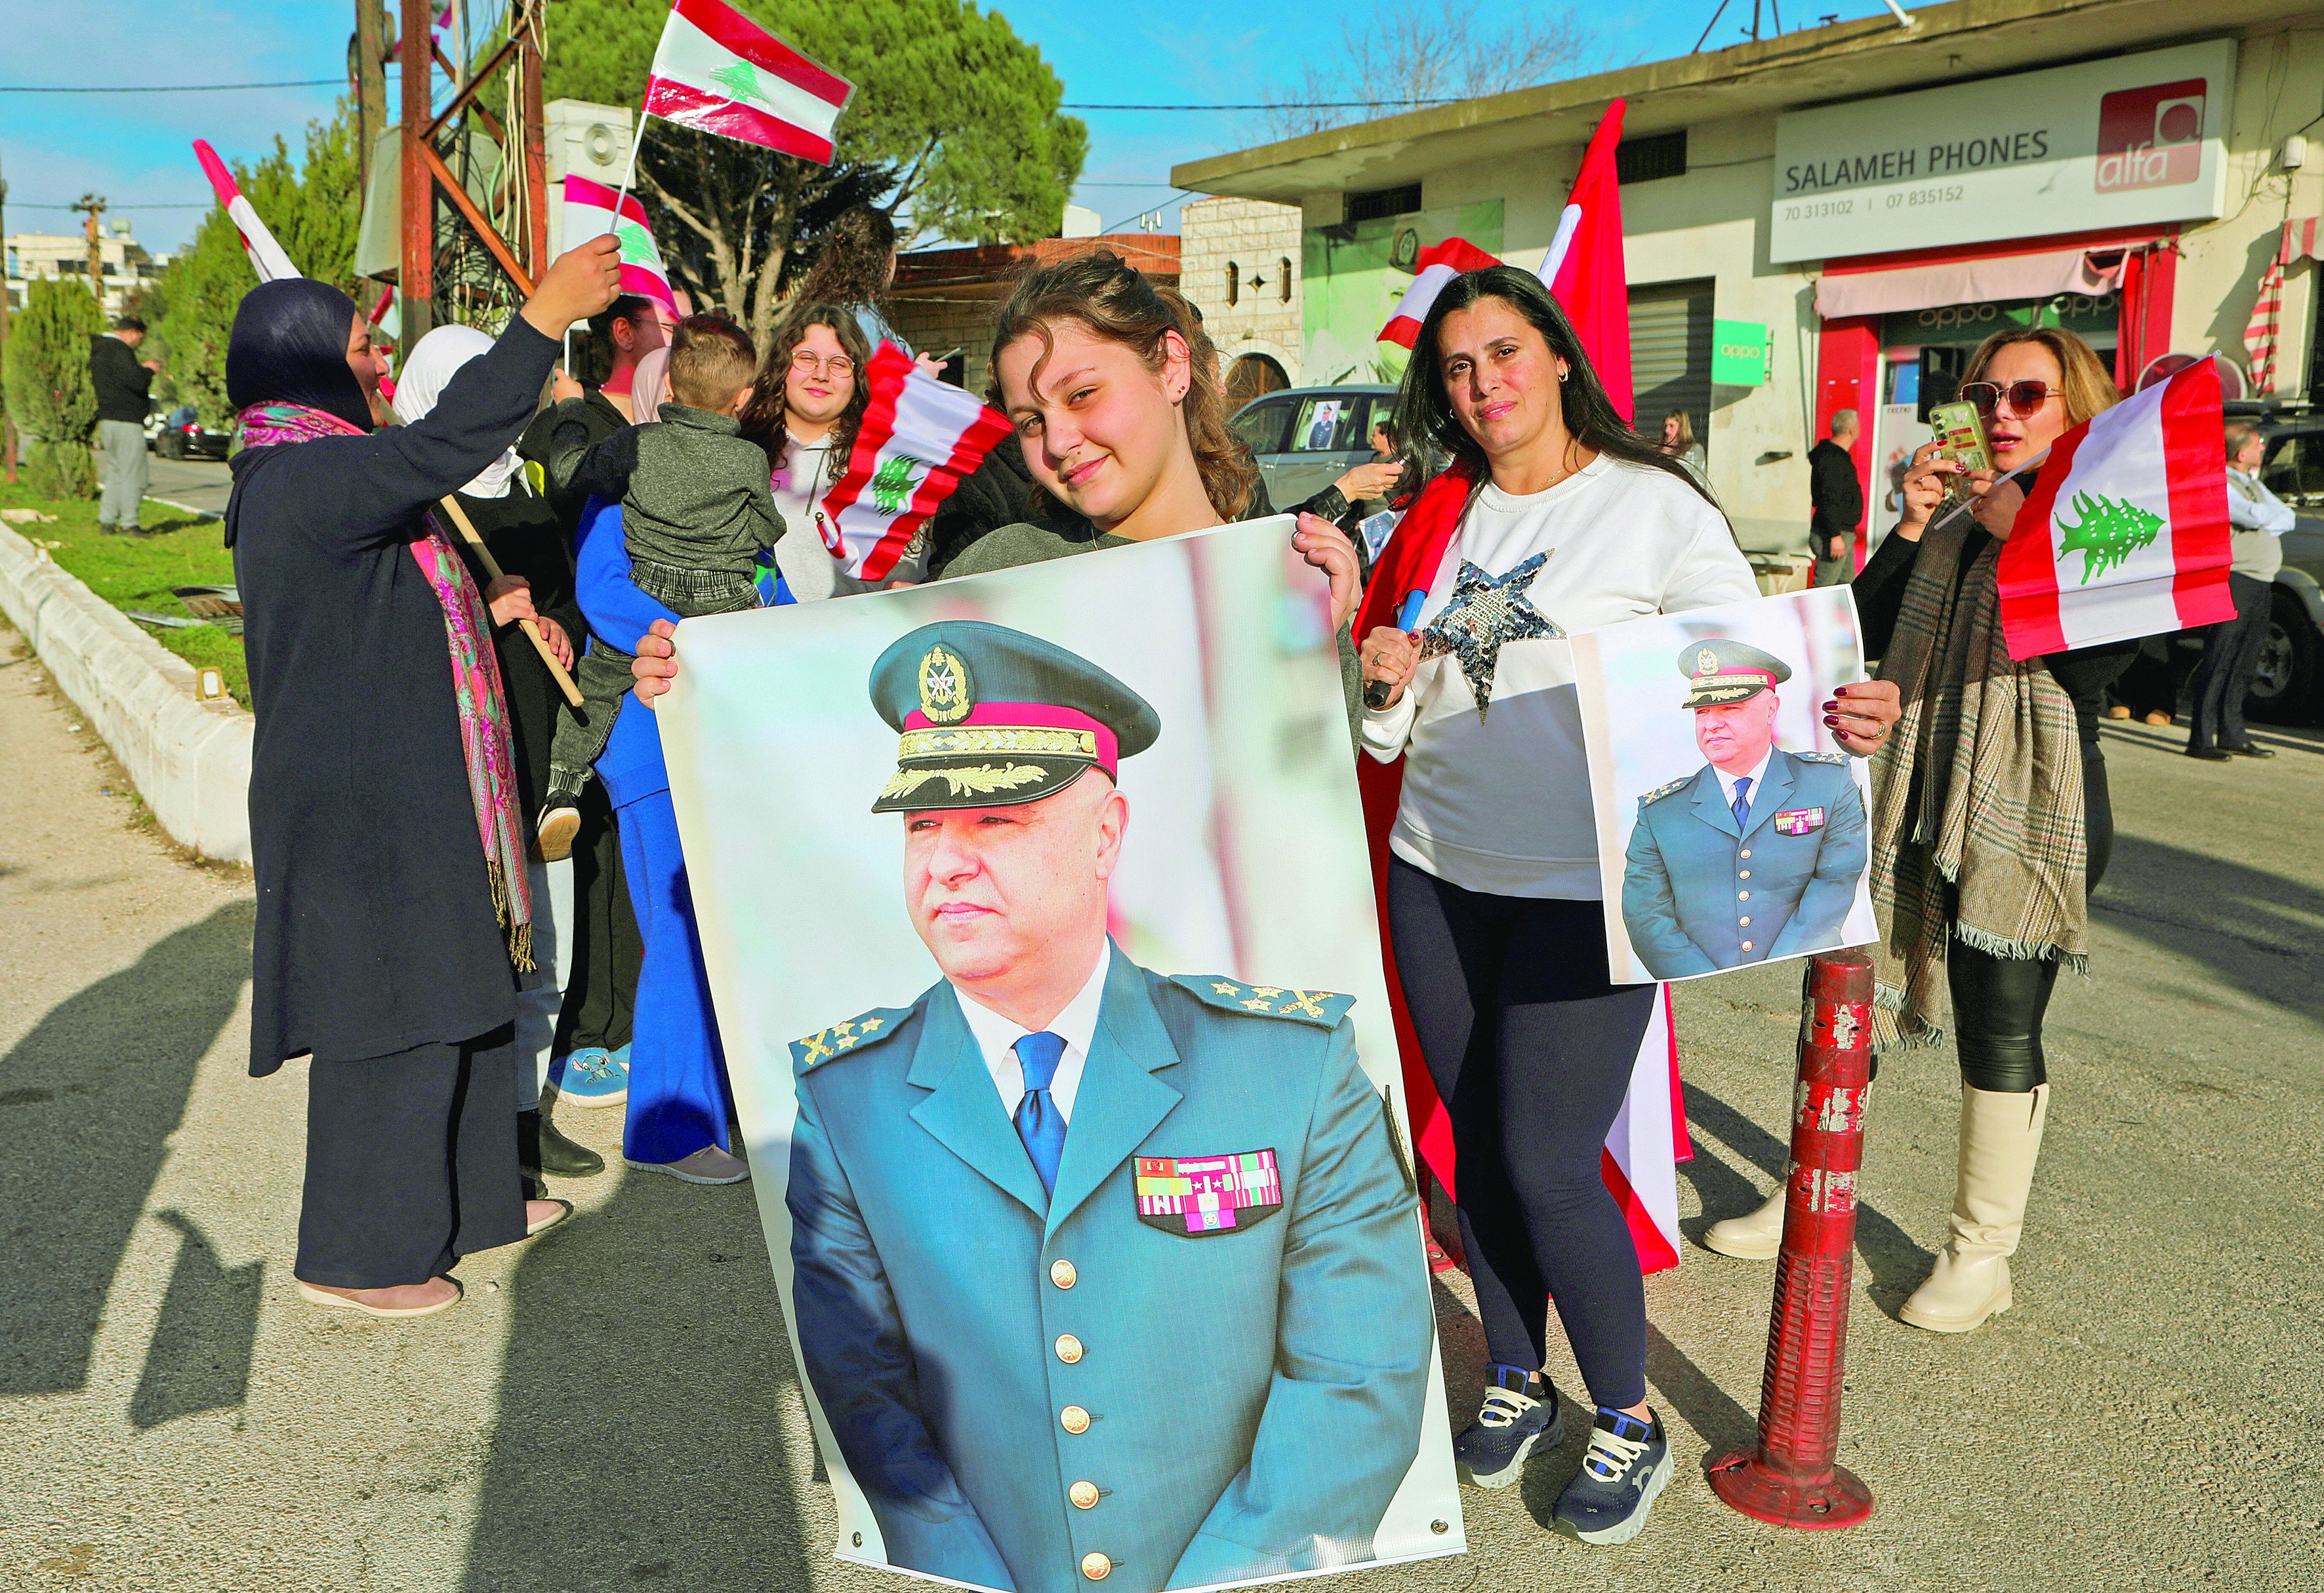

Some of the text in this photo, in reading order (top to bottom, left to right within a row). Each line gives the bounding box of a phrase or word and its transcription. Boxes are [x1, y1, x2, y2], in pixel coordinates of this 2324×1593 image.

[1786, 130, 2048, 192] SALAMEH PHONES
[2098, 140, 2169, 188] alfa
[1785, 207, 1800, 220] 70
[1805, 199, 1853, 219] 313102
[1886, 193, 1903, 209] 07
[1908, 186, 1964, 207] 835152
[1918, 304, 1997, 329] oppo
[1721, 343, 1761, 360] oppo
